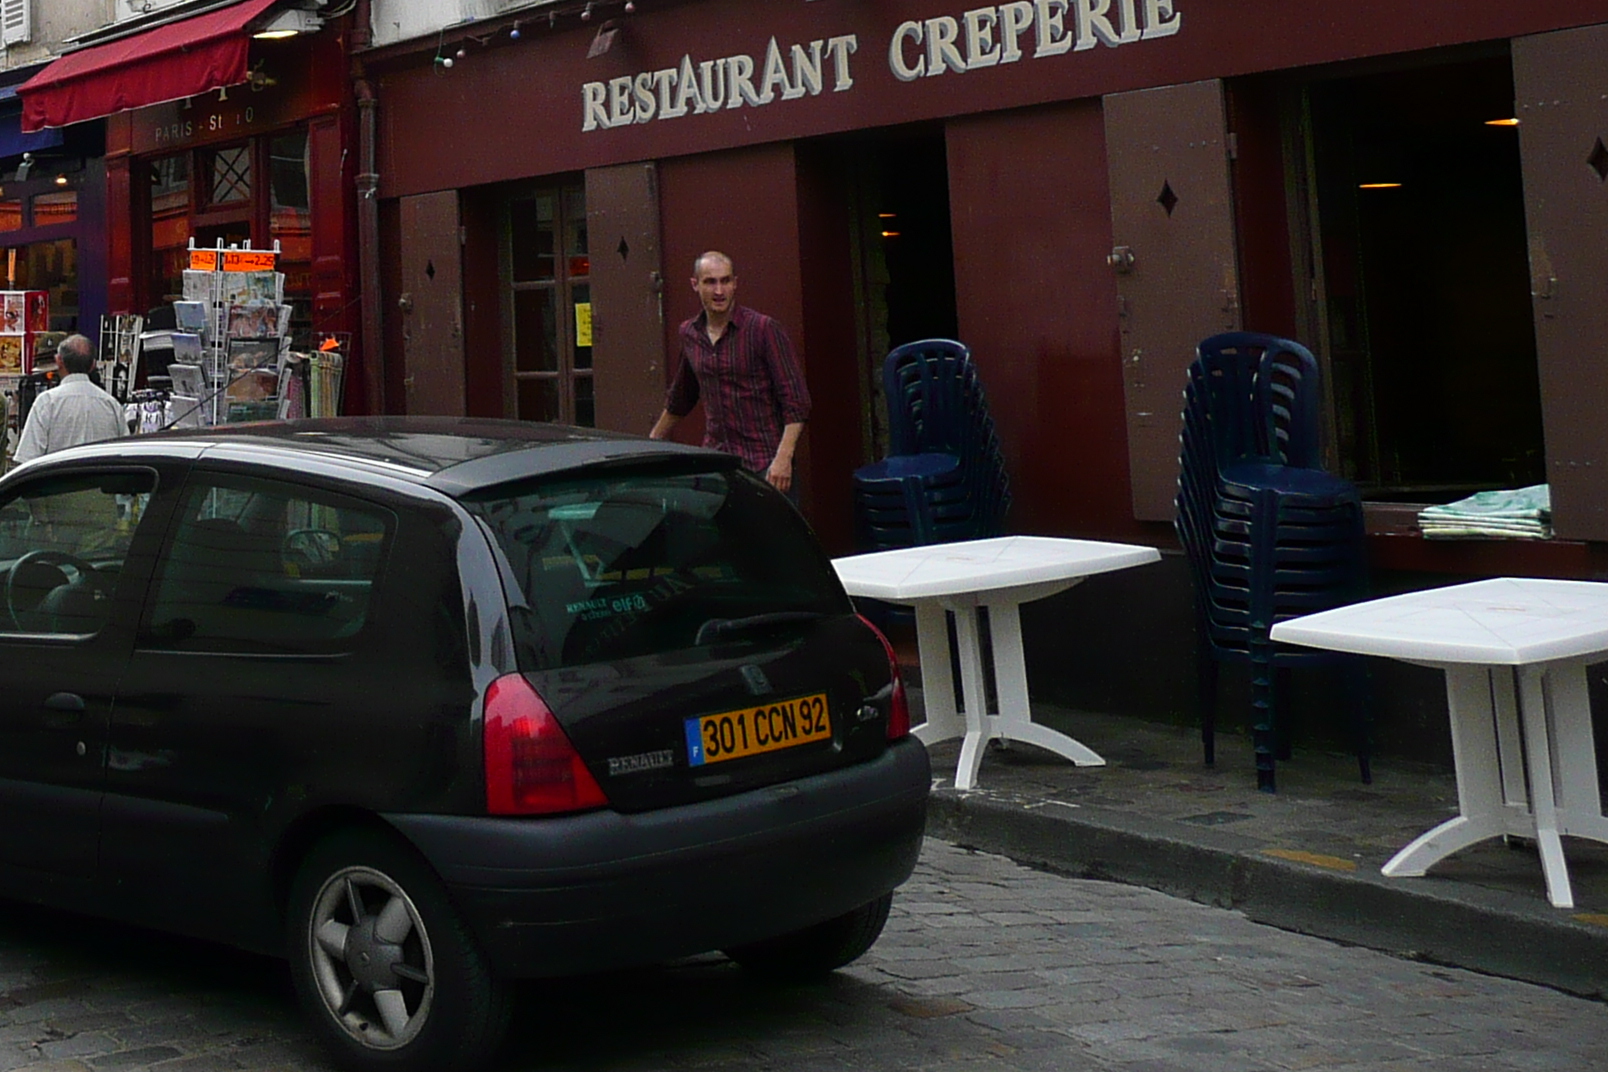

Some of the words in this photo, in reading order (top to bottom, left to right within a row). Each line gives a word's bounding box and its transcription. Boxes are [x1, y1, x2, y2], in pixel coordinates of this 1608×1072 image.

[582, 34, 858, 133] RESTAURANT
[155, 120, 193, 143] PARIS
[566, 597, 608, 614] RENAULT
[703, 715, 749, 758] 301
[753, 702, 798, 747] CCN
[798, 696, 827, 736] 92
[607, 750, 673, 776] RENAULT
[692, 745, 699, 758] F
